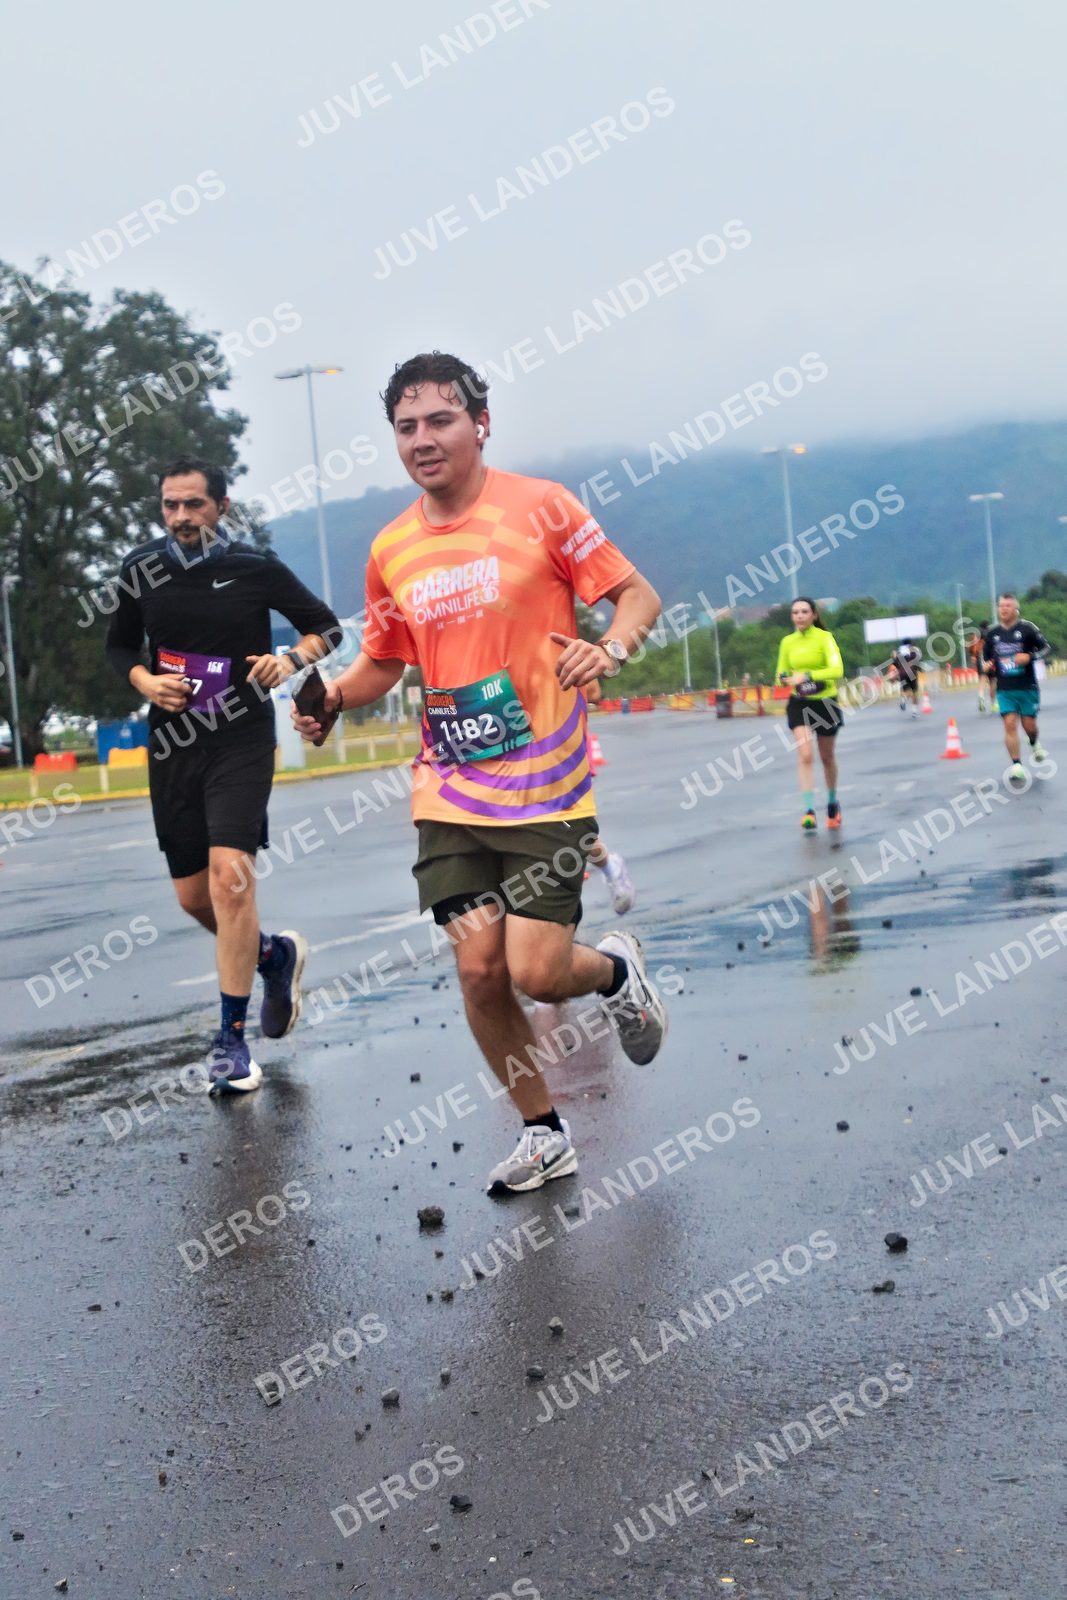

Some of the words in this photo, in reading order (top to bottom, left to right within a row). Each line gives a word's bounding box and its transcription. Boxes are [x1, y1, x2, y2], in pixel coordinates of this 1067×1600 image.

[412, 556, 499, 606] CARRERA
[415, 592, 479, 625] OMNILIFE
[207, 661, 224, 674] 15K
[482, 679, 503, 701] 10K
[440, 713, 498, 742] 1182
